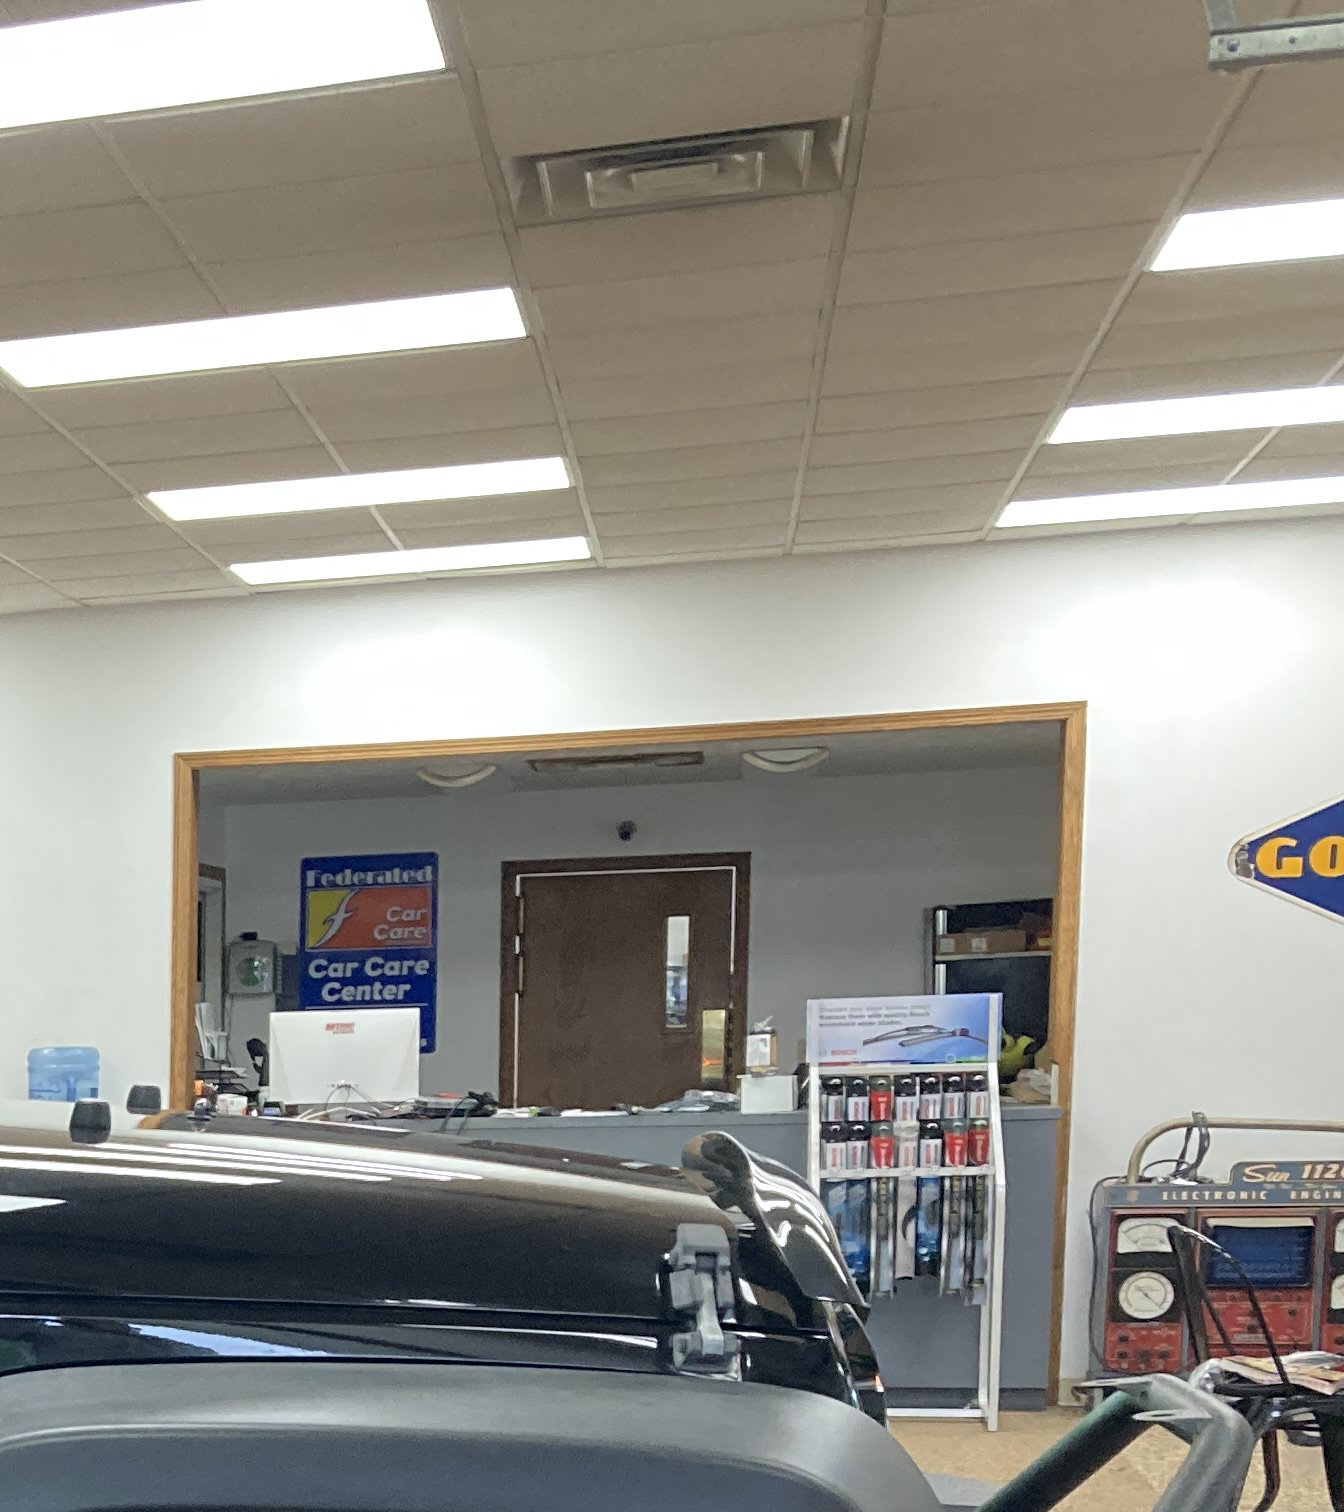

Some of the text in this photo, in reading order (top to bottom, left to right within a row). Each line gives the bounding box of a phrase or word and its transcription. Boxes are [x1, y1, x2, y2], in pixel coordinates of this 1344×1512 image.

[1255, 836, 1344, 878] GO
[306, 865, 432, 887] Federated
[386, 906, 427, 922] Car
[373, 924, 427, 940] Care
[308, 956, 430, 979] Car Care
[321, 981, 412, 1002] Center
[1242, 1163, 1344, 1182] Sun 112
[1162, 1190, 1268, 1201] ELECTRONIC
